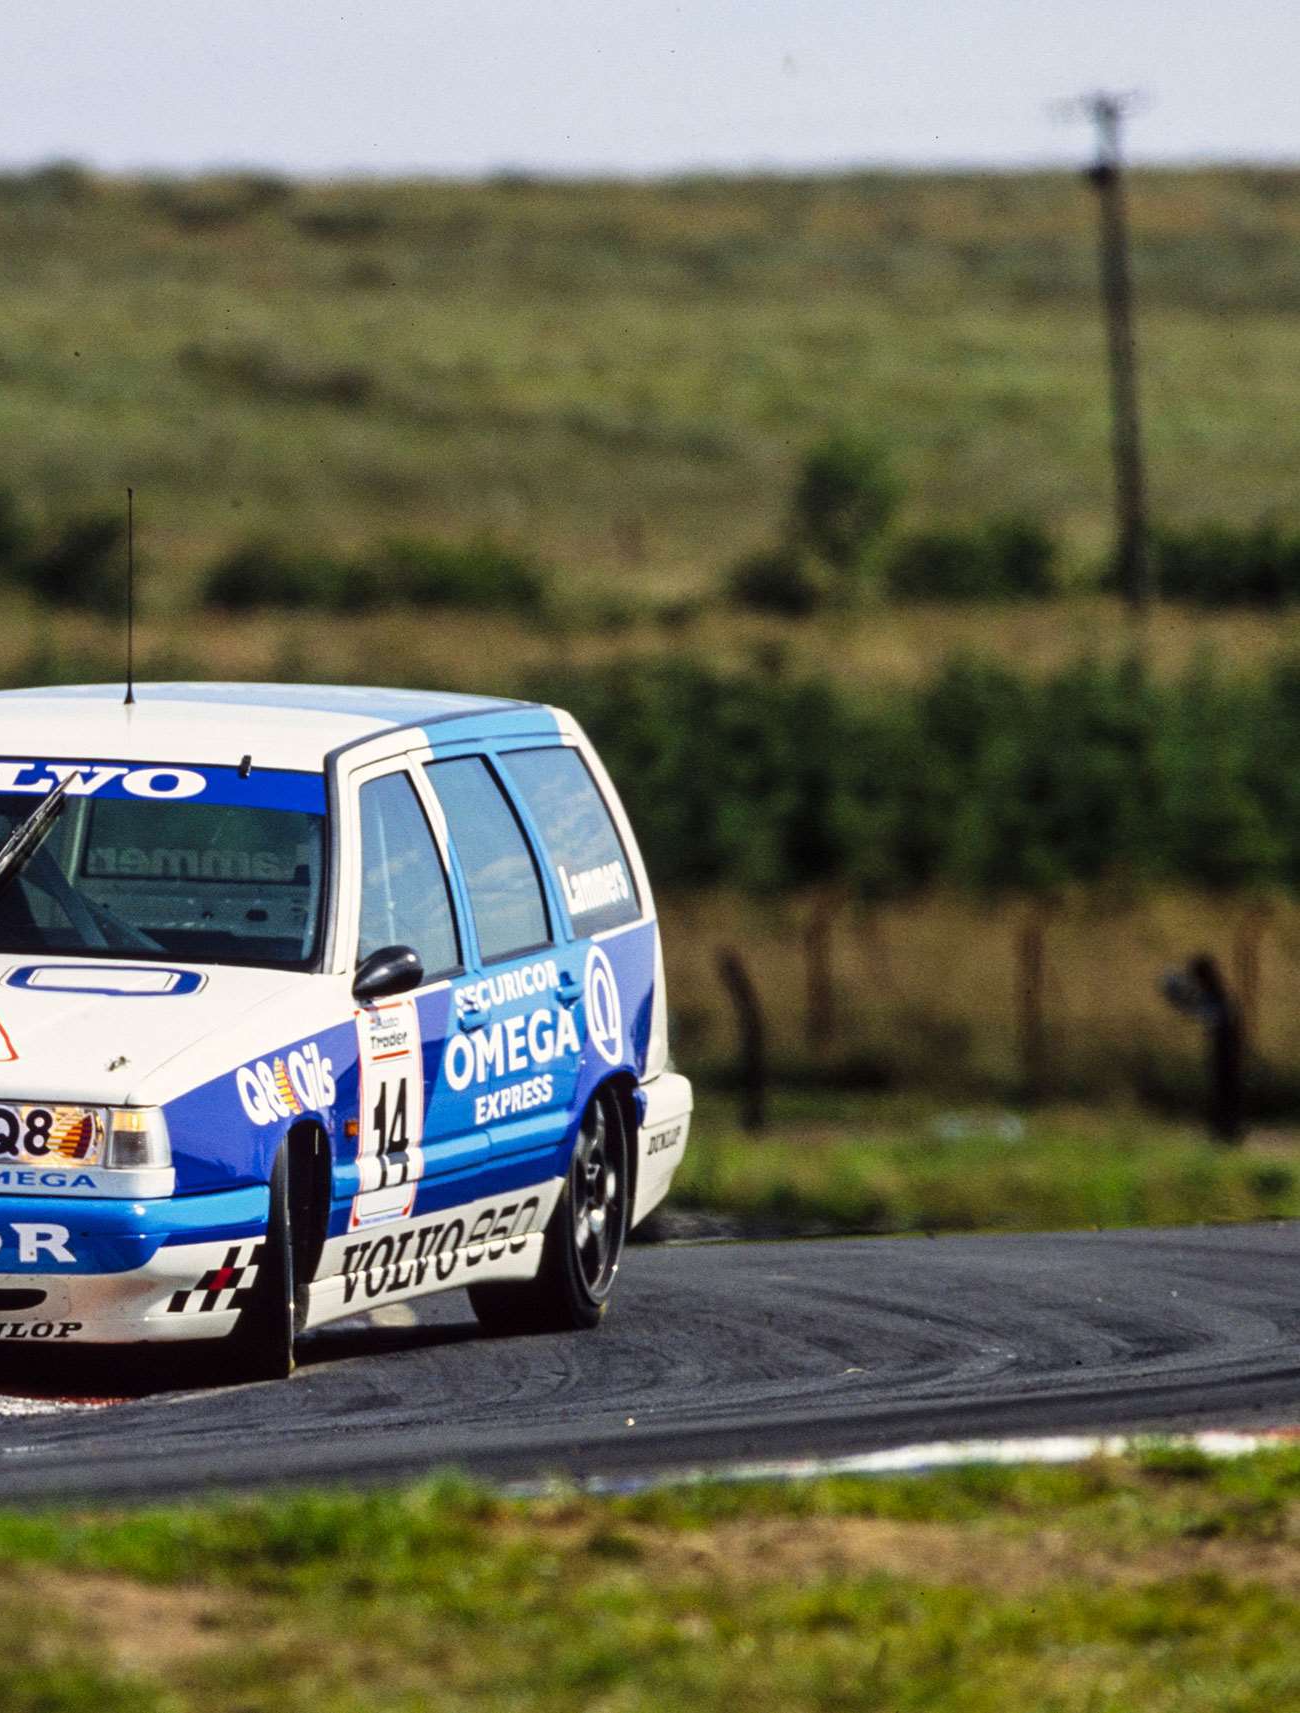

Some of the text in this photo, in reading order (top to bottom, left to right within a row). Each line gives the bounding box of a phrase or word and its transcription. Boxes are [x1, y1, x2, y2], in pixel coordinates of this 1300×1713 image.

[455, 960, 560, 1017] SECURICOR
[370, 1032, 407, 1050] Trader
[444, 1008, 581, 1091] OMEGA
[237, 1042, 336, 1126] Q8 Oils
[474, 1073, 554, 1125] EXPRESS
[373, 1077, 410, 1191] 14
[343, 1196, 540, 1304] VOLVO 850
